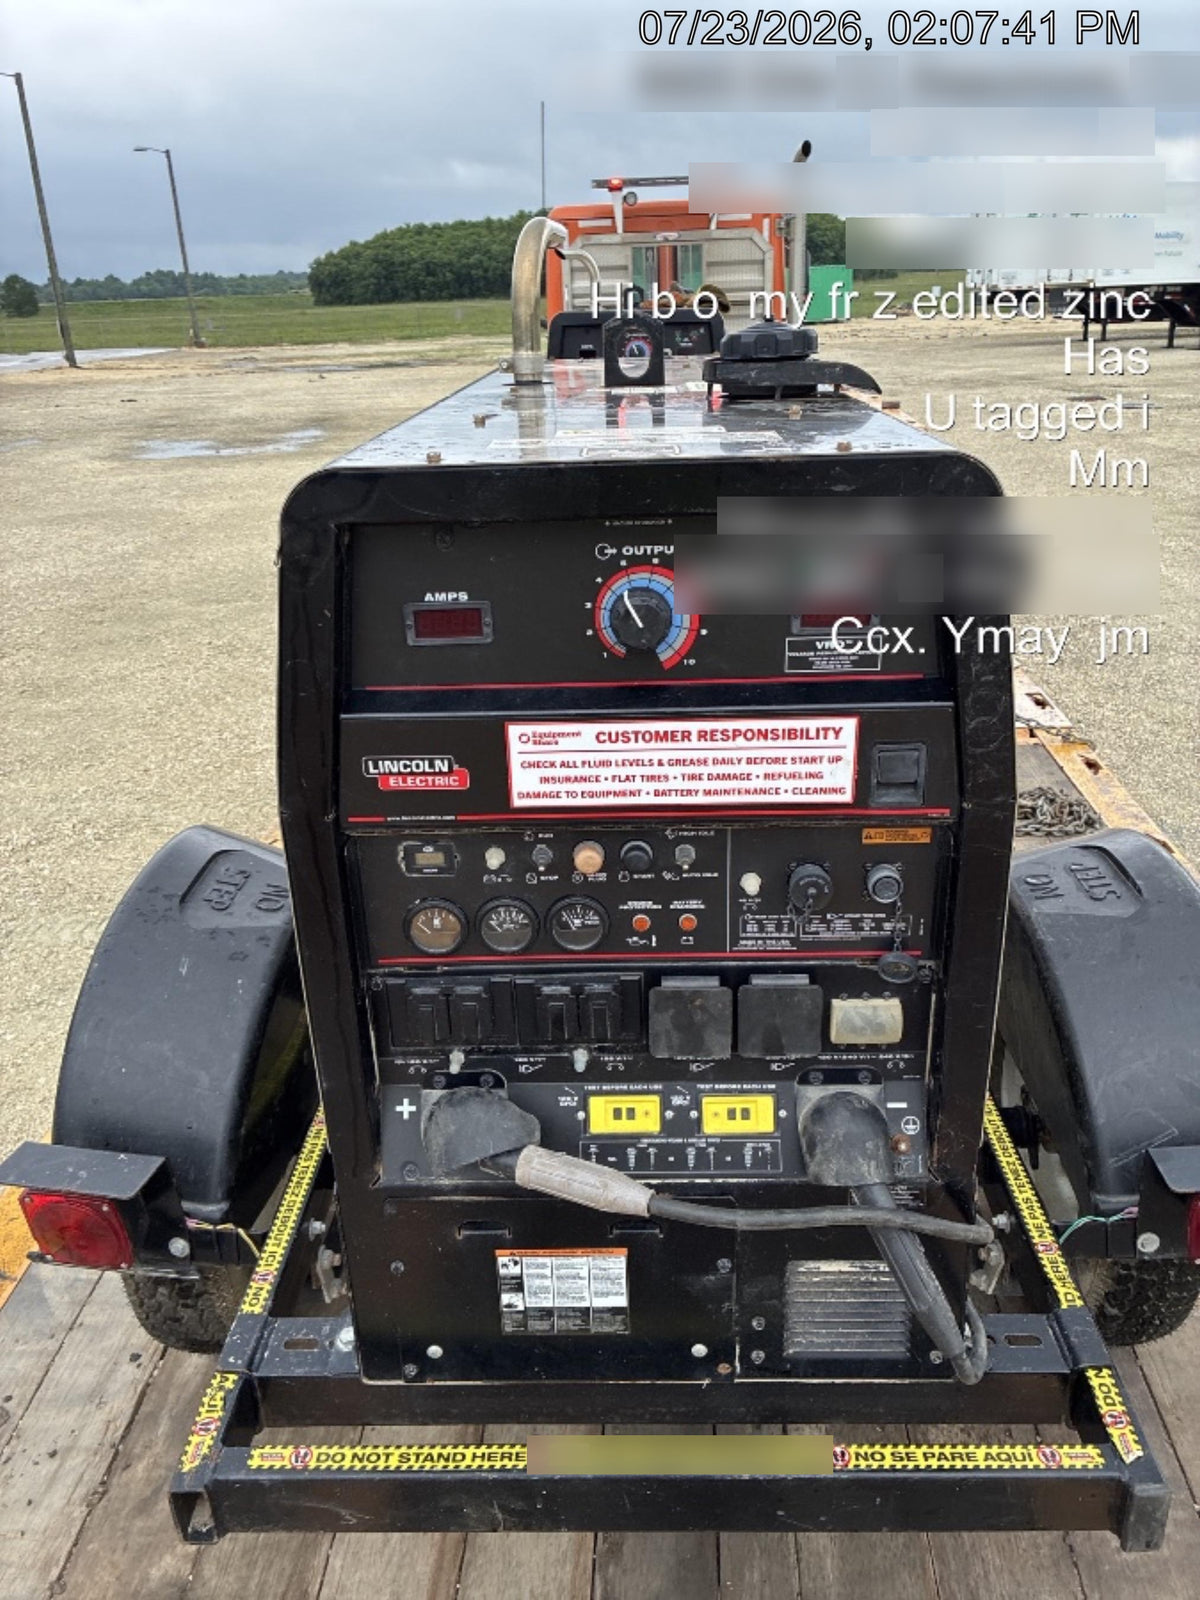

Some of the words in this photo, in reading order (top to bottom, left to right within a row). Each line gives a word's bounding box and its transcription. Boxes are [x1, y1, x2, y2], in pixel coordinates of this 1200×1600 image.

[622, 545, 675, 556] OUTPU
[424, 591, 468, 602] AMPS
[595, 730, 692, 744] CUSTOMER
[697, 727, 844, 742] RESPONSIBILITY
[368, 759, 449, 774] LINCOLN
[520, 760, 557, 769] CHECK
[559, 760, 579, 769] ALL
[581, 759, 613, 768] FLUID
[615, 758, 654, 768] LEVELS
[657, 758, 666, 767] &
[667, 757, 709, 767] GREASE
[712, 757, 742, 766] DAILY
[746, 756, 787, 765] BEFORE
[791, 755, 825, 765] START
[828, 755, 843, 764] UP
[388, 776, 460, 787] ELECTRIC
[539, 774, 601, 784] INSURANCE
[612, 774, 636, 783] FLAT
[640, 773, 669, 783] TIRES
[681, 772, 704, 781] TIRE
[707, 772, 753, 781] DAMAGE
[763, 771, 824, 780] REFUELING
[517, 790, 562, 800] DAMAGE
[564, 790, 578, 799] TO
[581, 789, 642, 798] EQUIPMENT
[653, 788, 700, 798] BATTERY
[703, 787, 781, 797] MAINTENANCE
[792, 787, 846, 796] CLEANING
[203, 866, 251, 911] STEP
[1024, 874, 1064, 900] NO
[1069, 862, 1121, 902] STEP
[1022, 1197, 1041, 1219] PAS
[271, 1199, 297, 1248] DEBOUT
[1032, 1222, 1048, 1239] NE
[264, 1251, 277, 1266] ICI
[248, 1286, 264, 1307] NO
[1098, 1383, 1117, 1406] DO
[316, 1452, 346, 1464] DO
[350, 1452, 392, 1464] NOT
[397, 1452, 467, 1463] STAND
[471, 1451, 527, 1462] HERE
[854, 1451, 886, 1462] NO
[890, 1451, 918, 1463] SE
[922, 1451, 979, 1462] PARE
